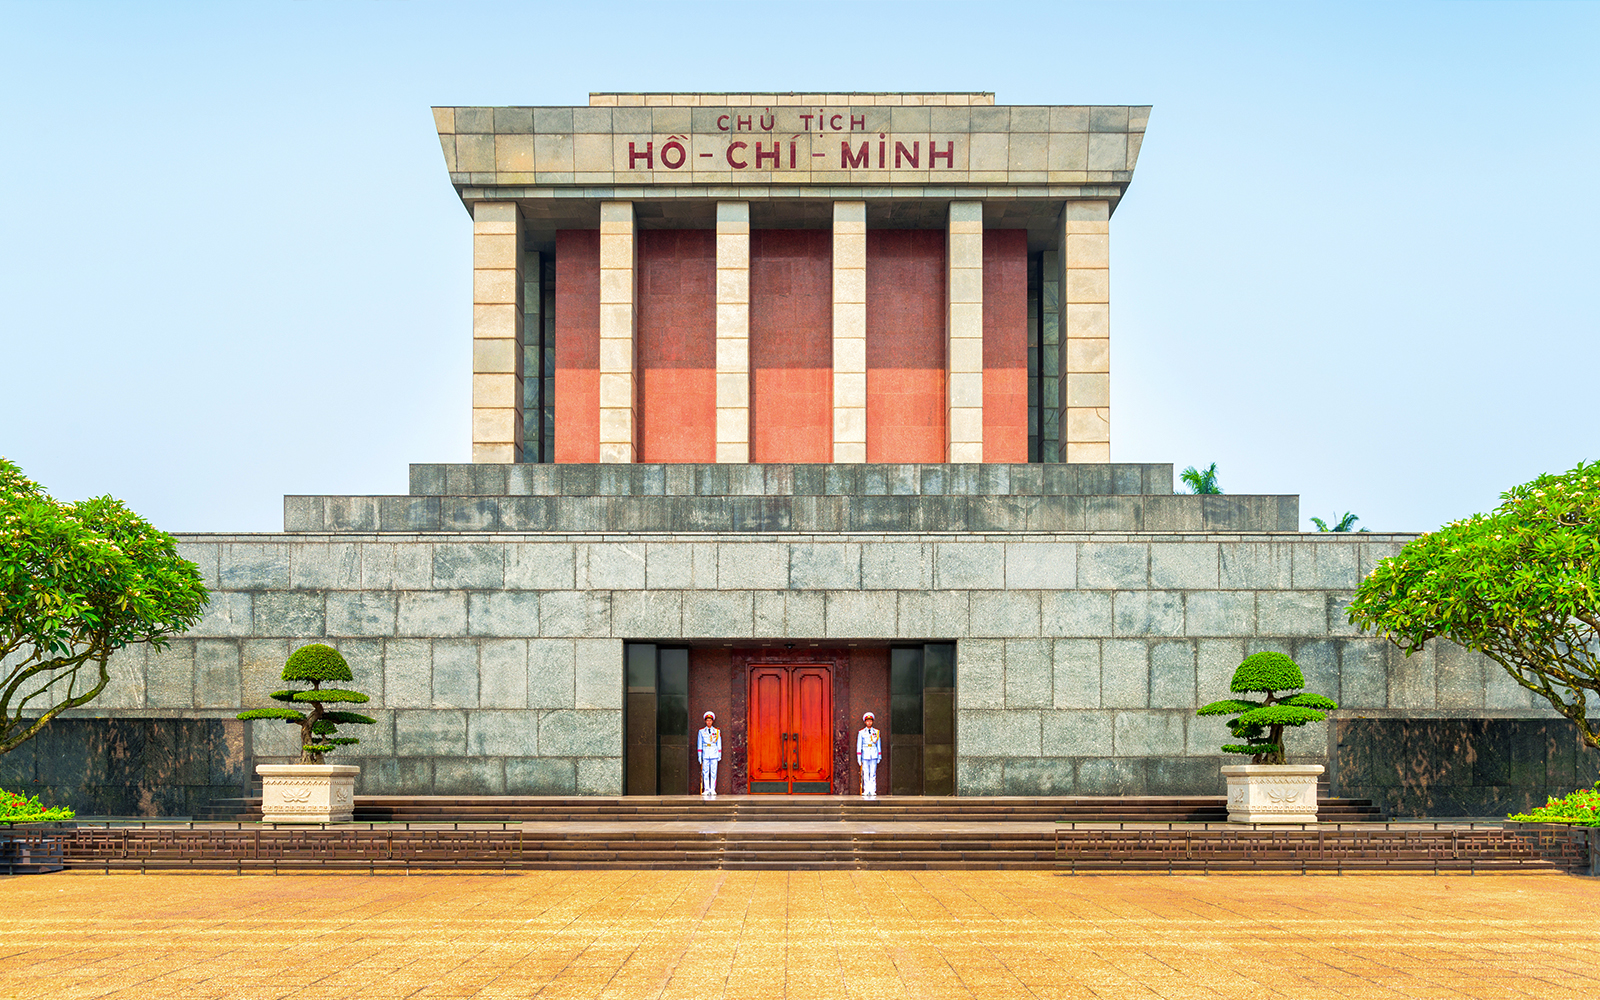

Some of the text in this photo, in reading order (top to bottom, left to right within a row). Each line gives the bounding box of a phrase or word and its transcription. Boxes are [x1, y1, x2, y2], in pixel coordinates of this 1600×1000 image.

[717, 108, 775, 131] CHỦ
[628, 135, 689, 170] HỒ
[726, 134, 800, 170] CHÍ
